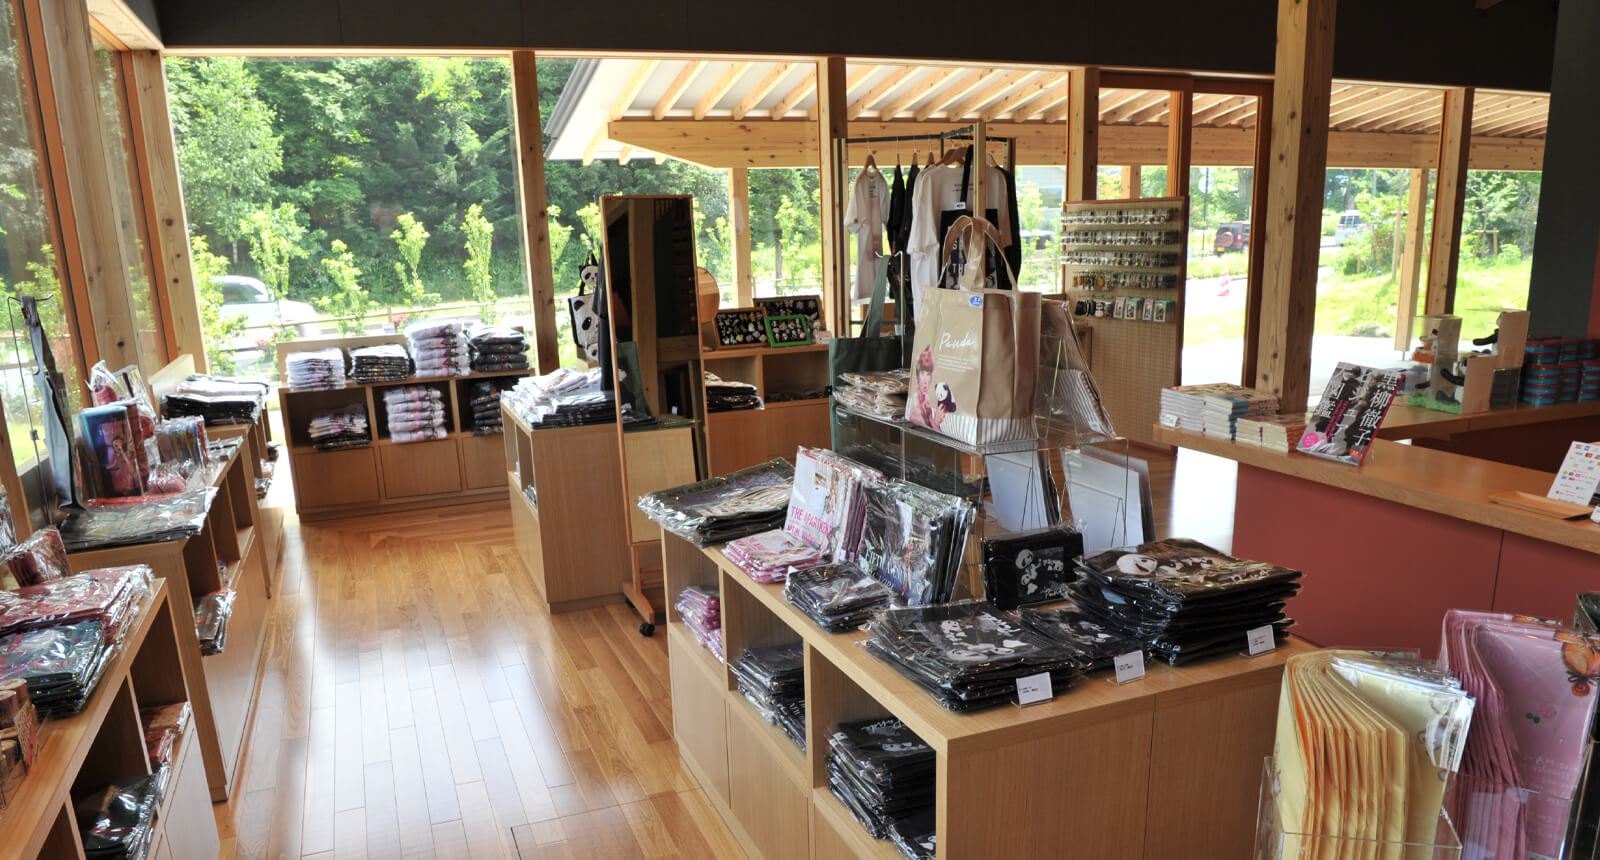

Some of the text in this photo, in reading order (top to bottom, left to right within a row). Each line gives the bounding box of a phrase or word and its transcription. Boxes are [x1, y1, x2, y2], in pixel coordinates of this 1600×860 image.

[1353, 372, 1401, 446] 黒柳徹子
[791, 505, 803, 521] THE
